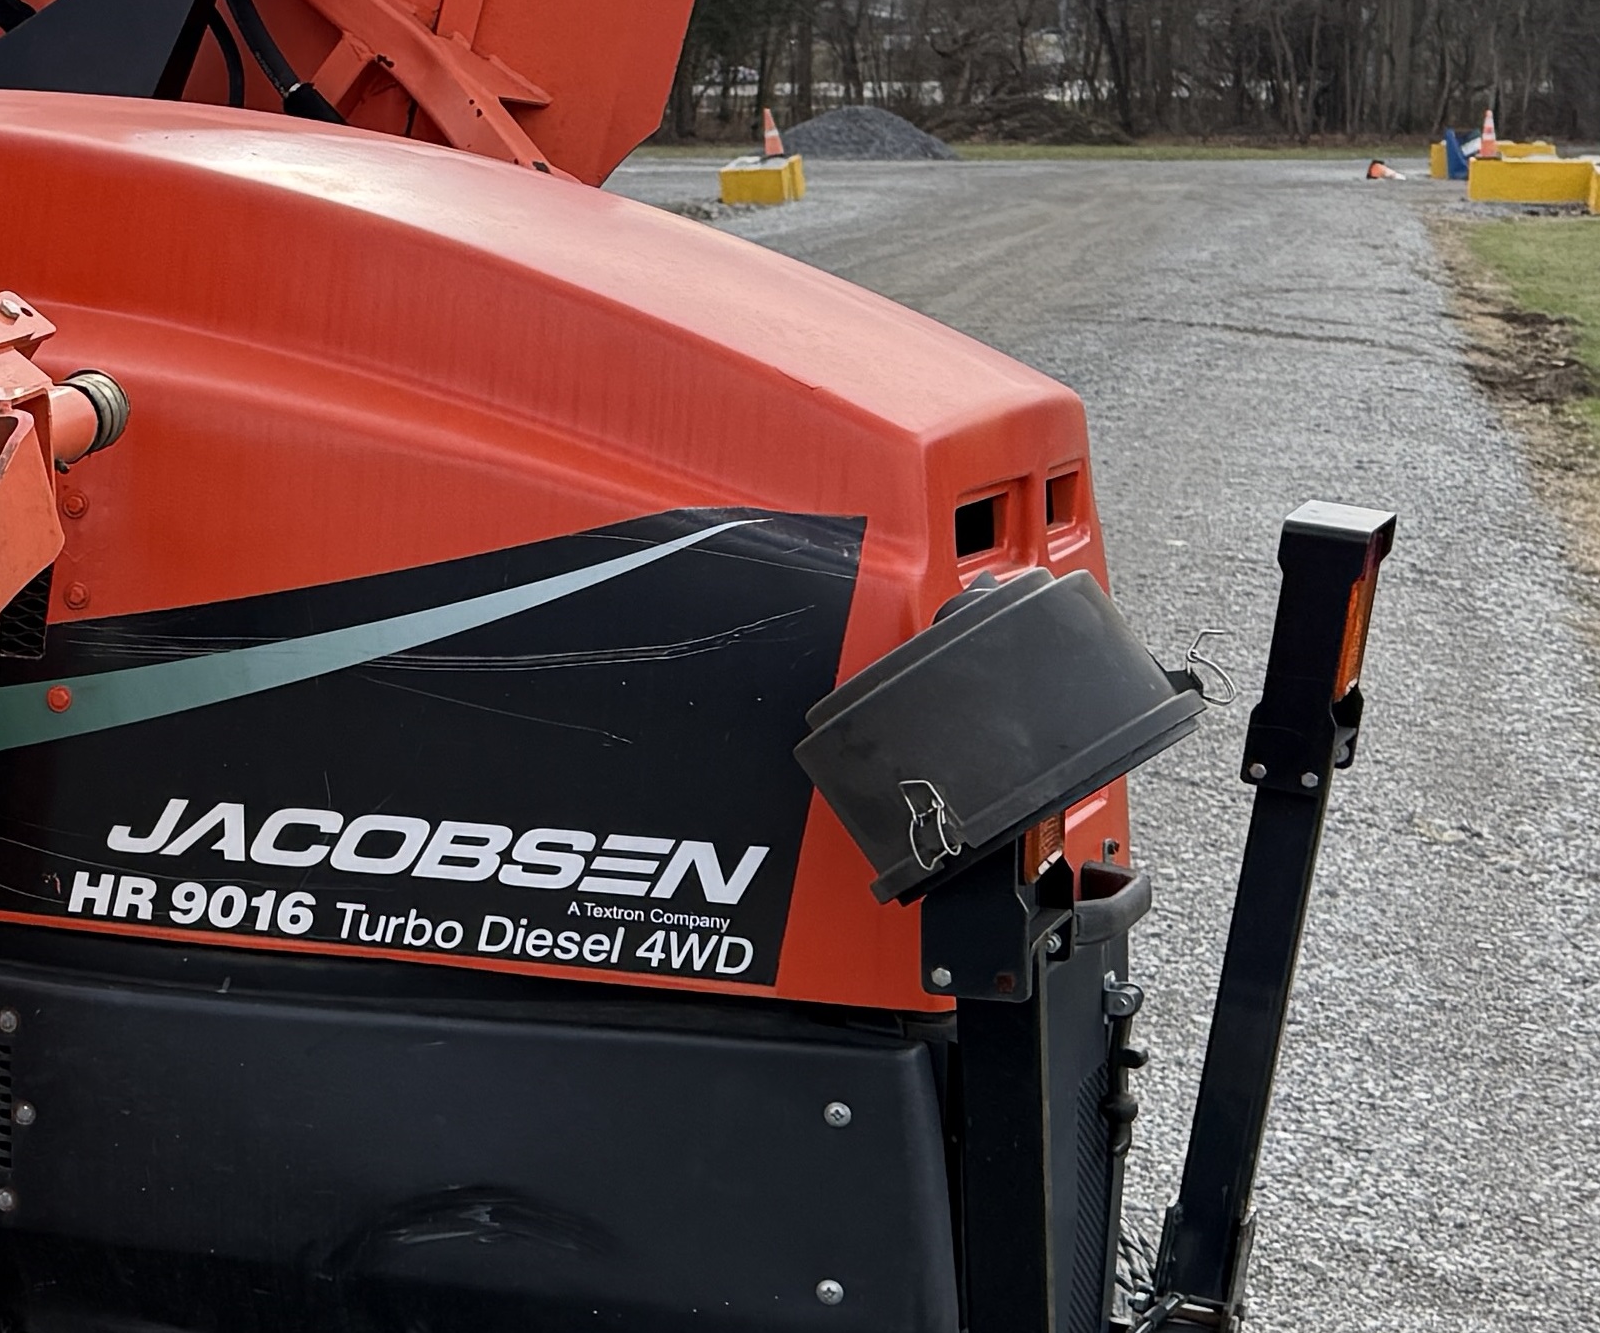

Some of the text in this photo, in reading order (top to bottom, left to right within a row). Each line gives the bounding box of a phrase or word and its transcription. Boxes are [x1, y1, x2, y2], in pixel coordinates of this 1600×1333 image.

[106, 797, 770, 905] JACOBSEN
[67, 870, 754, 975] HR 9016 Turbo Diesel 4WD
[566, 901, 732, 934] A Textron Company
